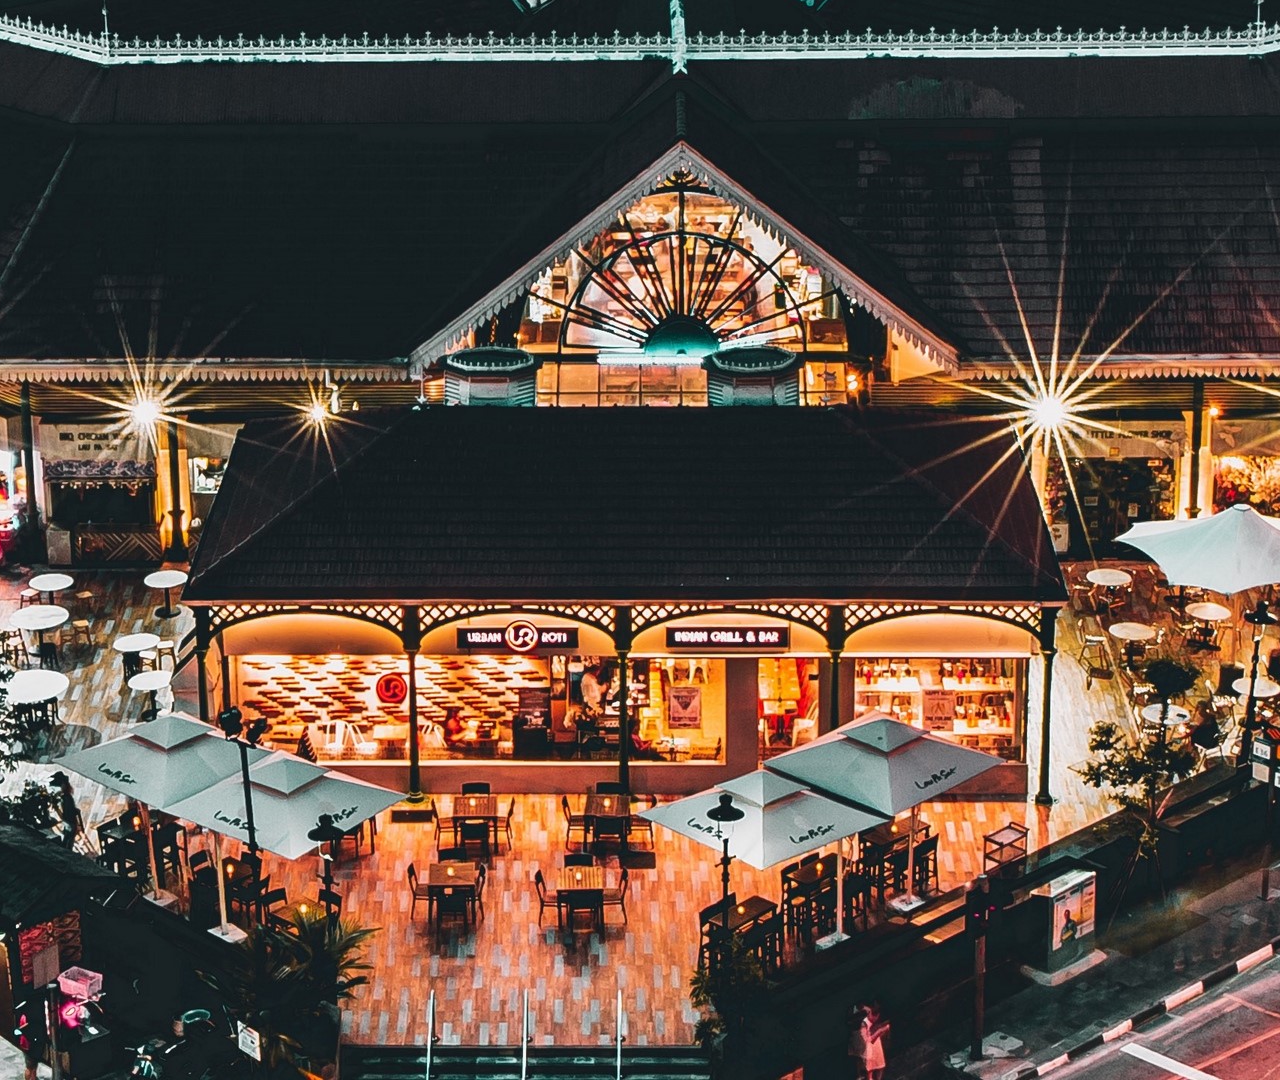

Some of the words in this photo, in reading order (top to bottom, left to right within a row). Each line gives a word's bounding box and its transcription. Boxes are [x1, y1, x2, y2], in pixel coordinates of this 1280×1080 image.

[467, 632, 501, 642] URBAN
[541, 632, 567, 642] ROTI
[710, 631, 743, 642] GRILL
[758, 631, 779, 642] BAR
